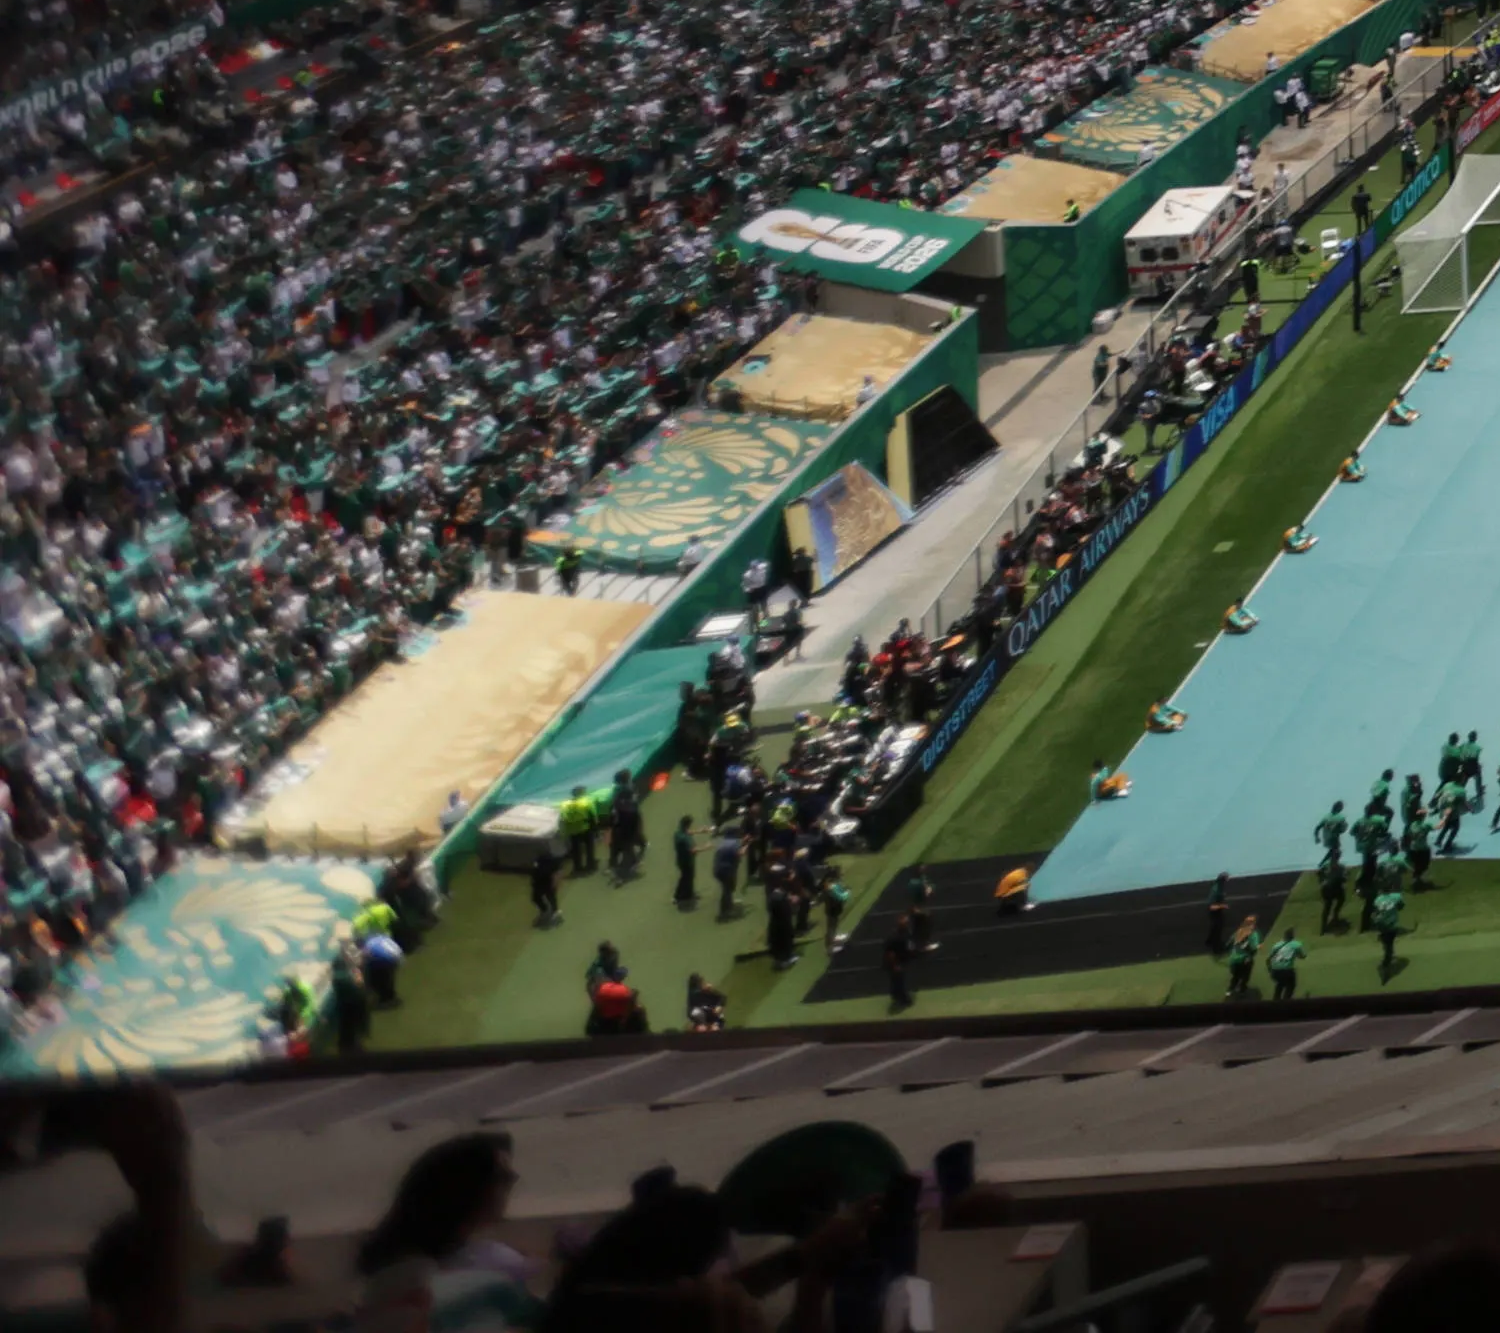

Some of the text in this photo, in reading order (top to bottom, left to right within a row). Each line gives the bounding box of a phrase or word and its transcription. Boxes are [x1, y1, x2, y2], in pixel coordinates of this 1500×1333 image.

[1390, 153, 1440, 225] aramco
[1198, 382, 1239, 446] VISA
[1007, 484, 1152, 658] QATAR AIRWAYS
